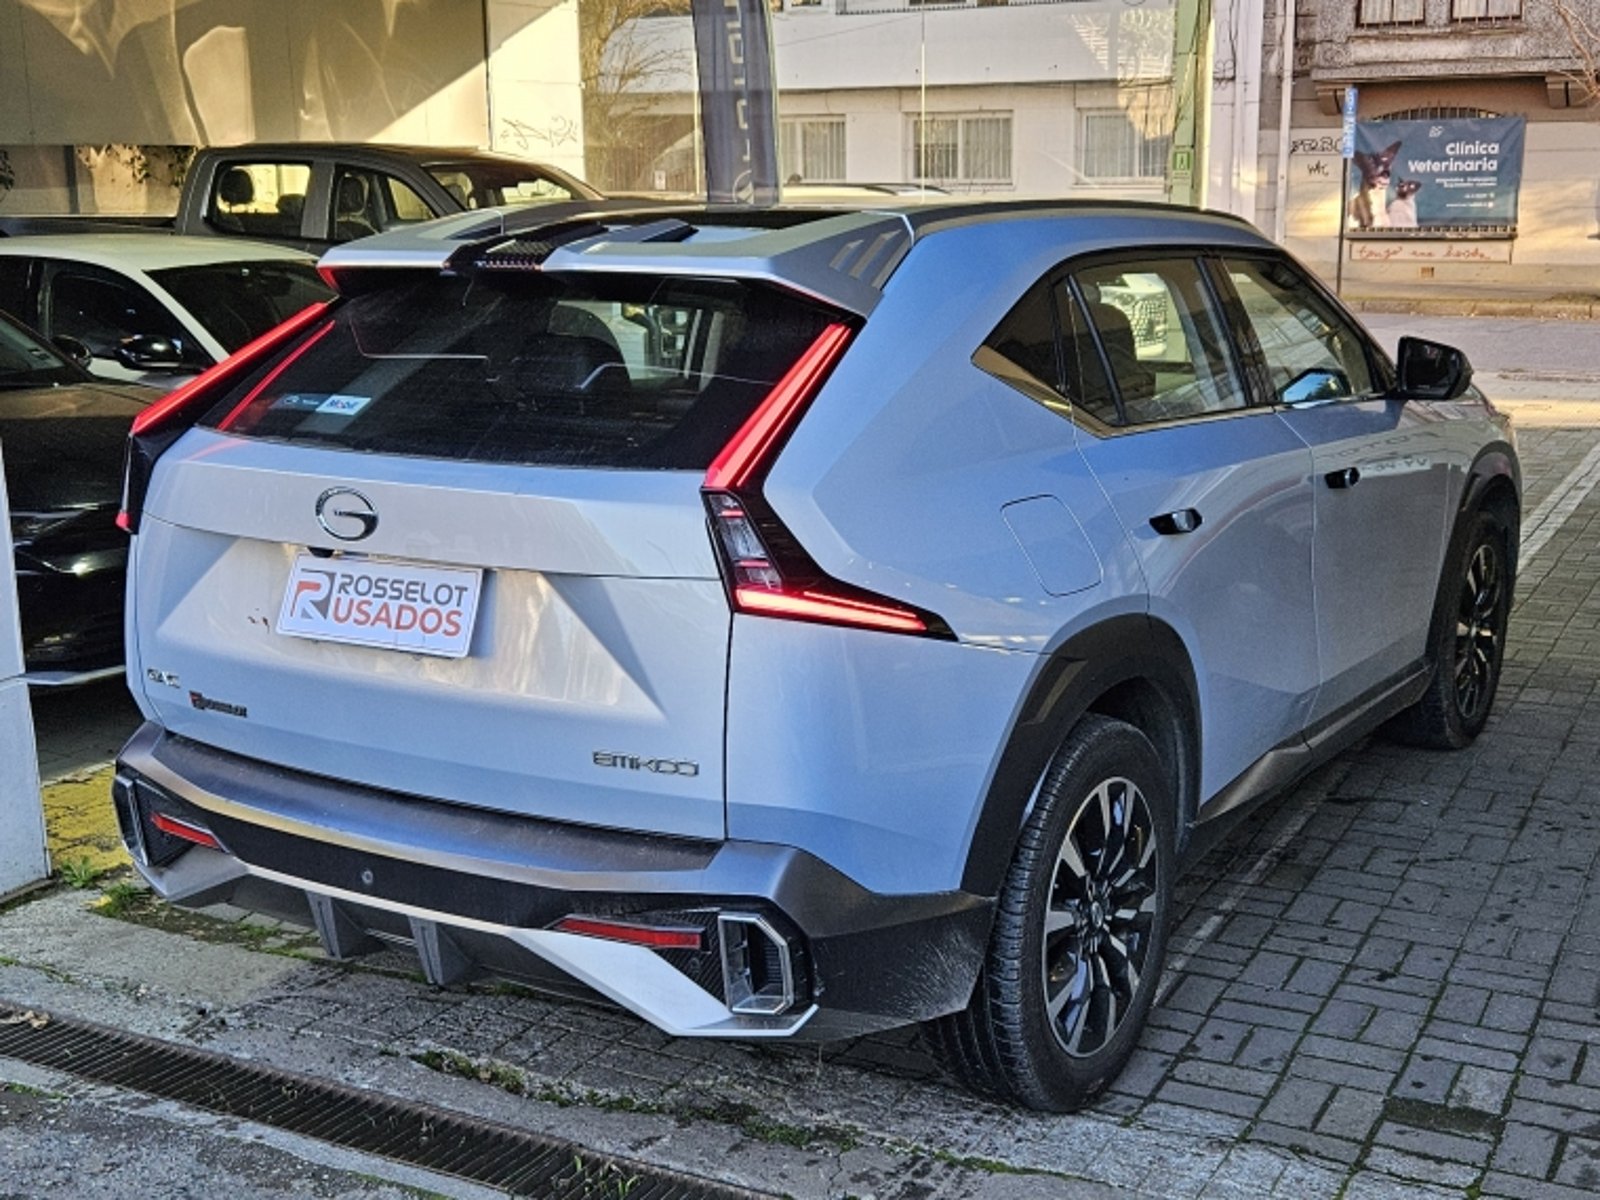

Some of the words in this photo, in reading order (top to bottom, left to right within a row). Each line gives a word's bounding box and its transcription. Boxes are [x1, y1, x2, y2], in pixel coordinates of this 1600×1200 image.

[1445, 140, 1500, 155] Clínica
[1407, 157, 1498, 173] Veterinaria
[337, 573, 468, 607] ROSSELOT
[332, 597, 463, 637] USADOS
